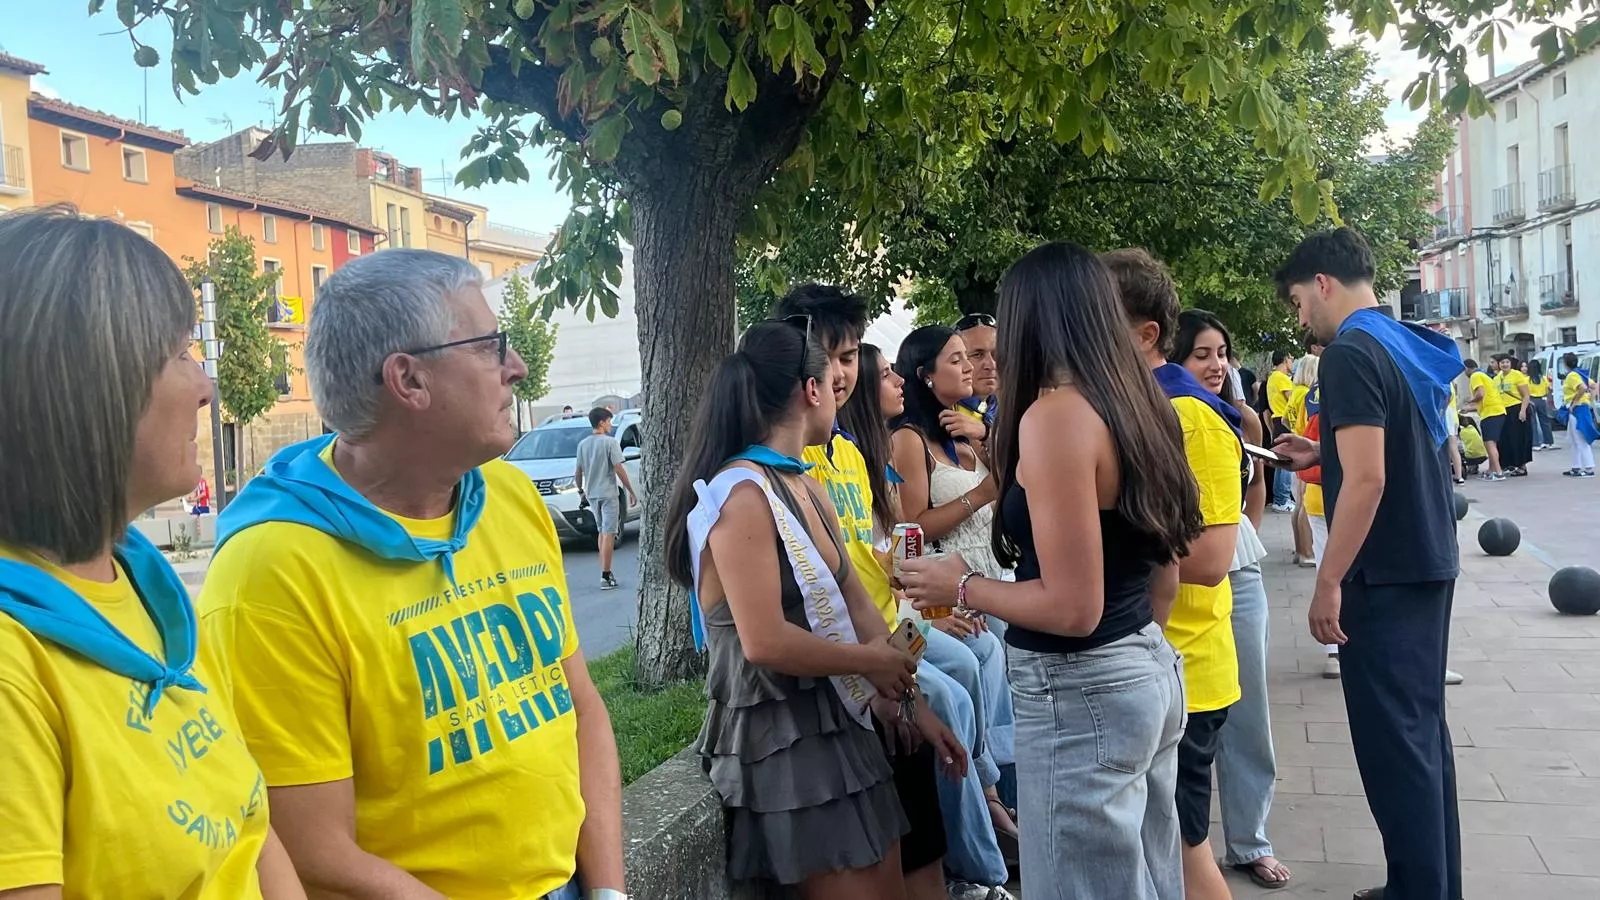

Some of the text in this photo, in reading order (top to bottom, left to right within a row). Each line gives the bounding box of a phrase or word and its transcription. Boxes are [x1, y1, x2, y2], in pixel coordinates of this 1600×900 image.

[443, 573, 507, 603] FIESTAS
[811, 587, 835, 628] 2026
[449, 695, 506, 726] SANTA
